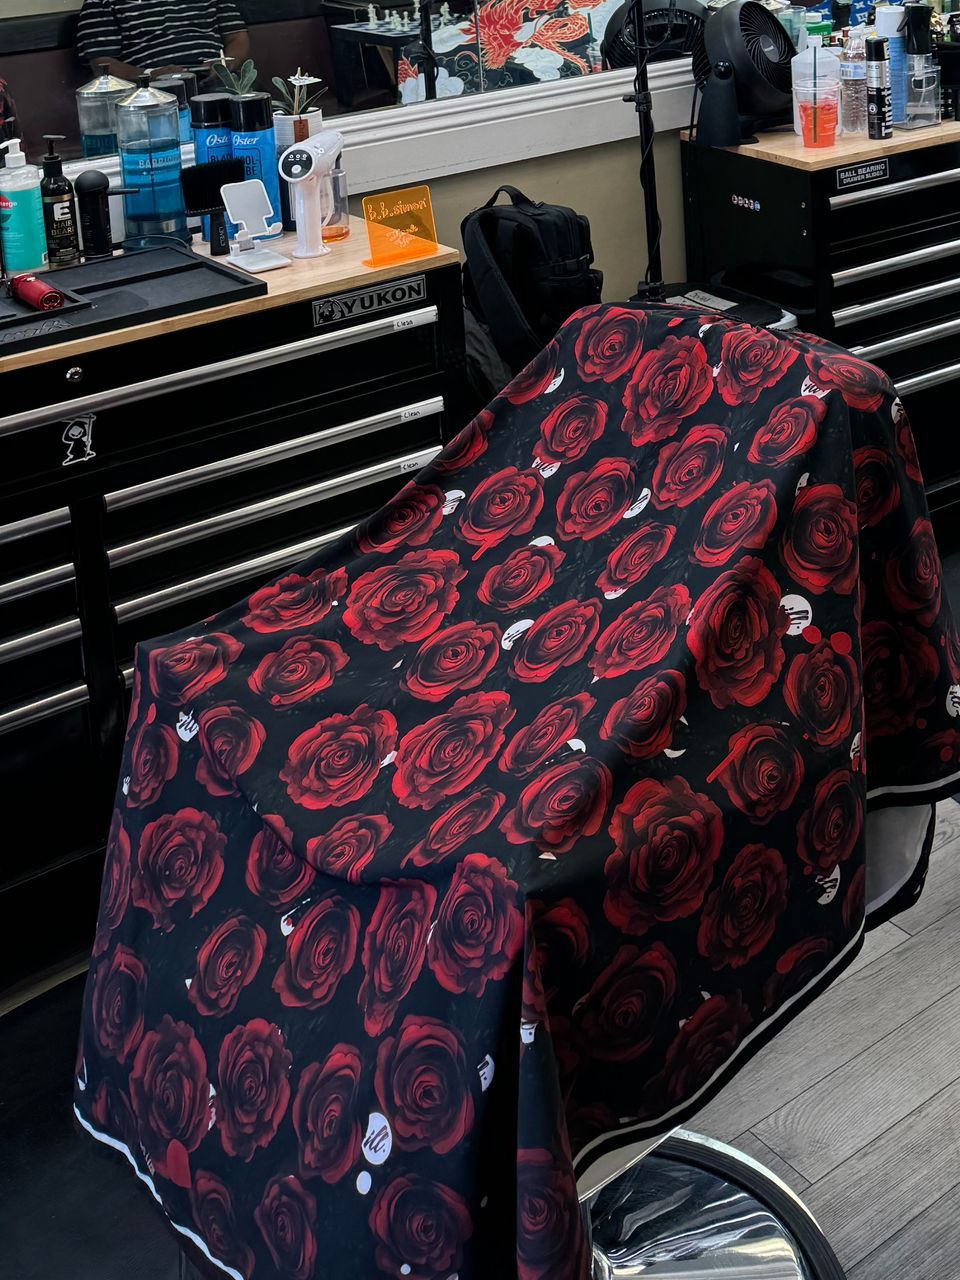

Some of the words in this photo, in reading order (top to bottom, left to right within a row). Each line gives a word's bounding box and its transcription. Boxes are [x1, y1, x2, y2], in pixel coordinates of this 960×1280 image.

[233, 135, 260, 146] Oster
[840, 170, 856, 179] BALL
[858, 163, 885, 175] BEARING
[53, 220, 73, 230] HAIR
[343, 282, 421, 314] YUKON
